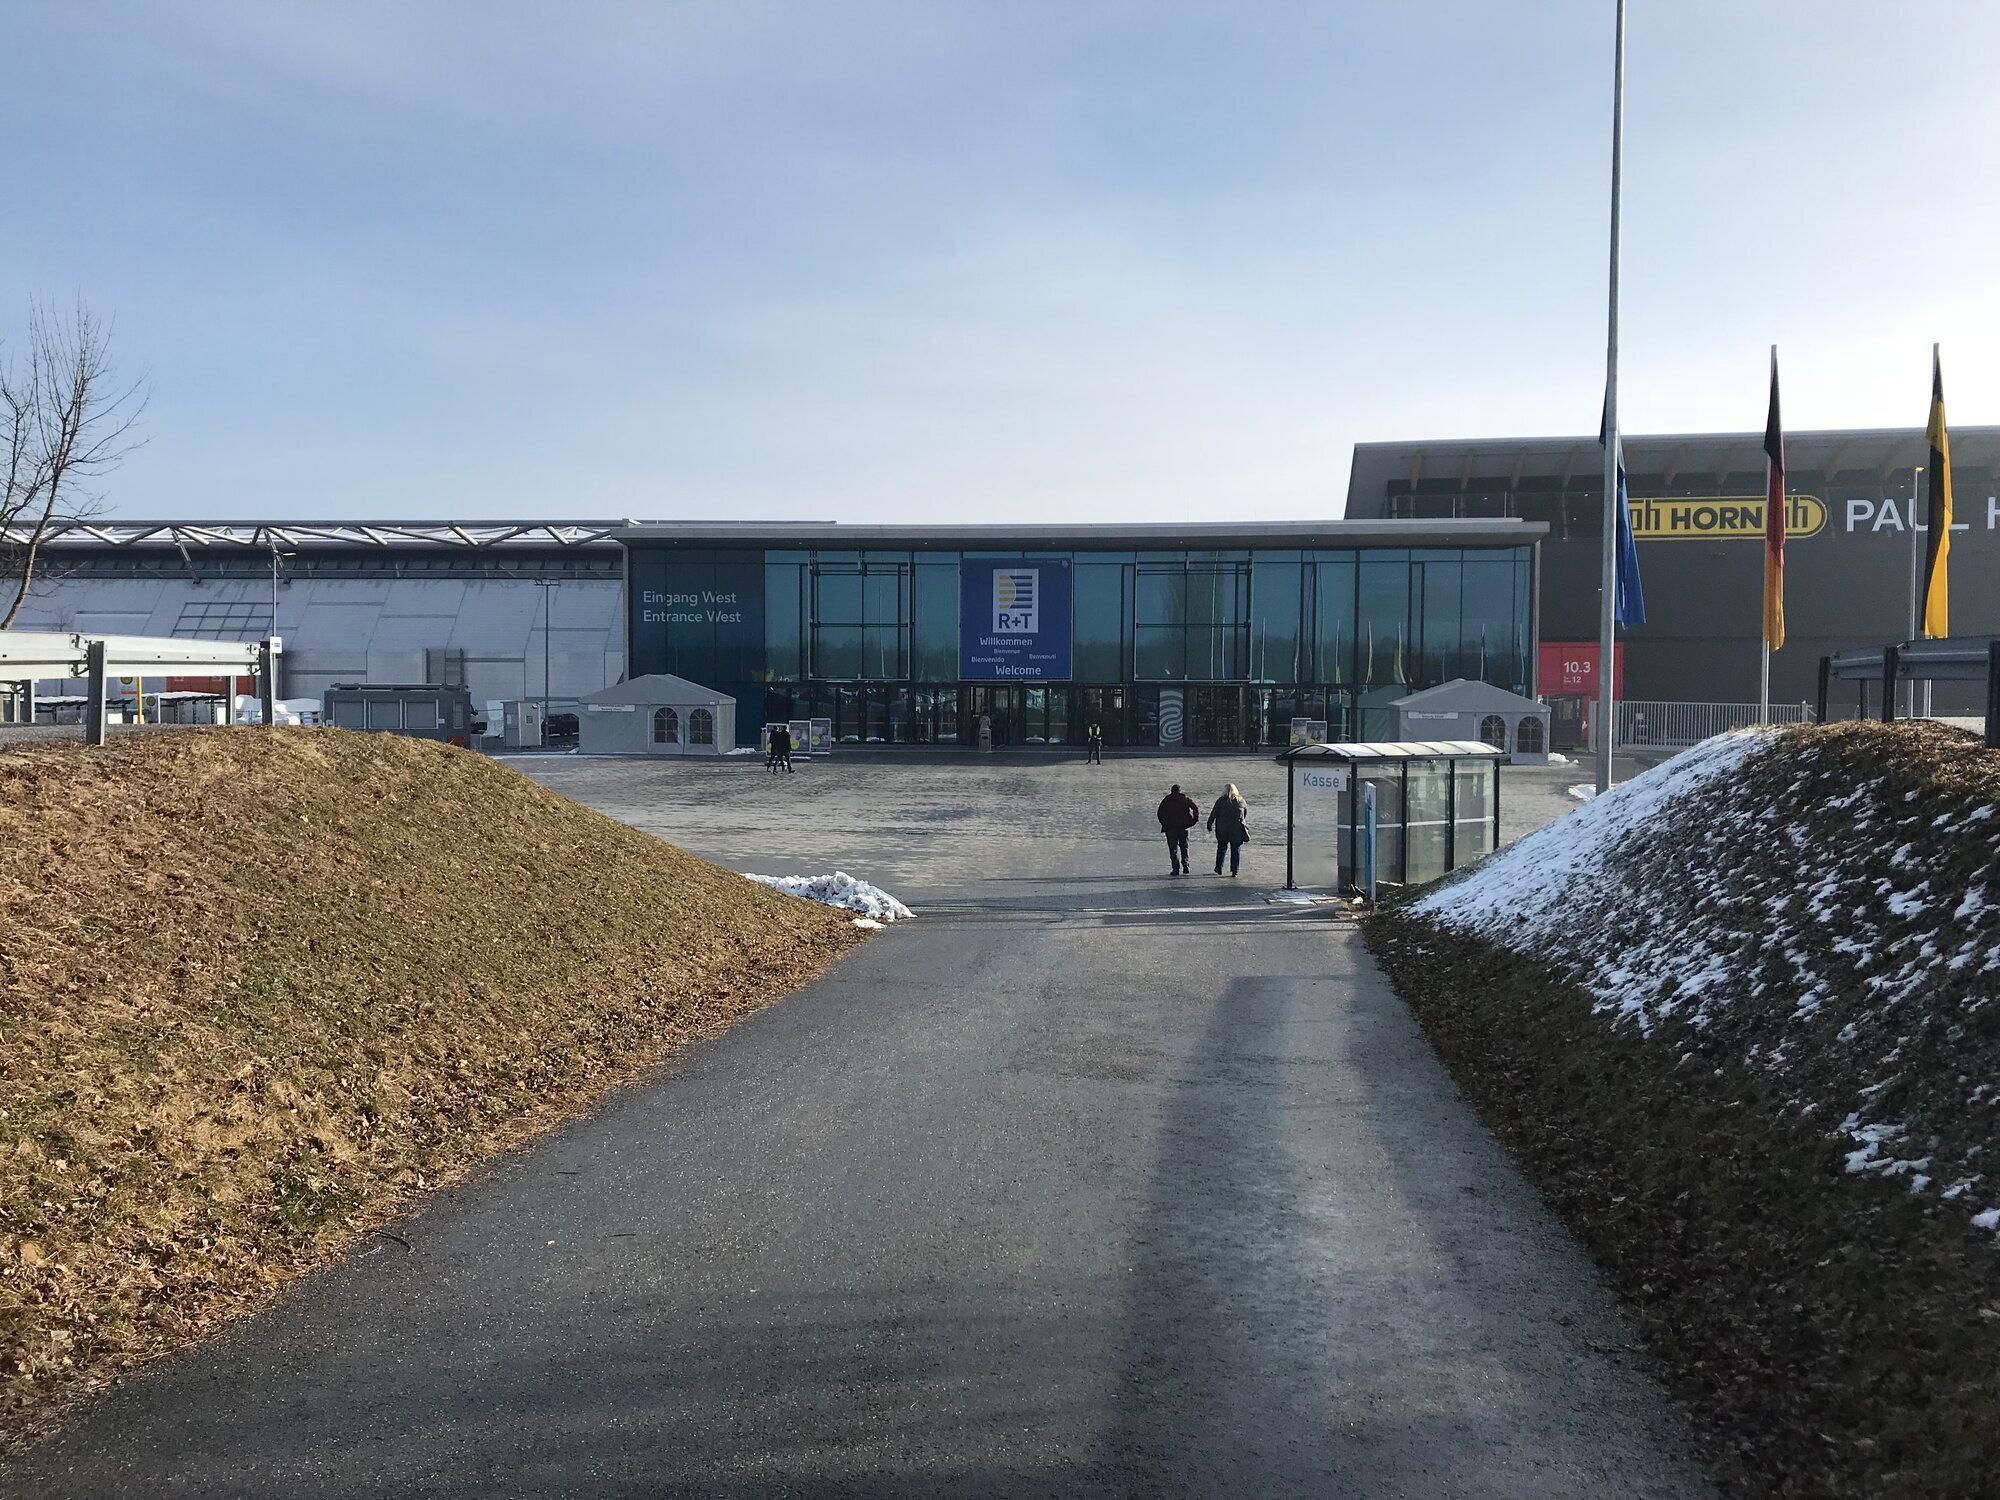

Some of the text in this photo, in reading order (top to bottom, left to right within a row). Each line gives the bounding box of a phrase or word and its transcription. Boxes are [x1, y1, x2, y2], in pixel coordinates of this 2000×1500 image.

[1670, 505, 1763, 530] HORN
[643, 590, 738, 607] Eingang West
[643, 609, 741, 623] Entrance West
[998, 613, 1033, 630] R+T
[979, 637, 1033, 647] Willkommen
[995, 665, 1042, 676] Welcome
[1563, 661, 1591, 673] 10.3
[1303, 772, 1340, 788] Kasse
